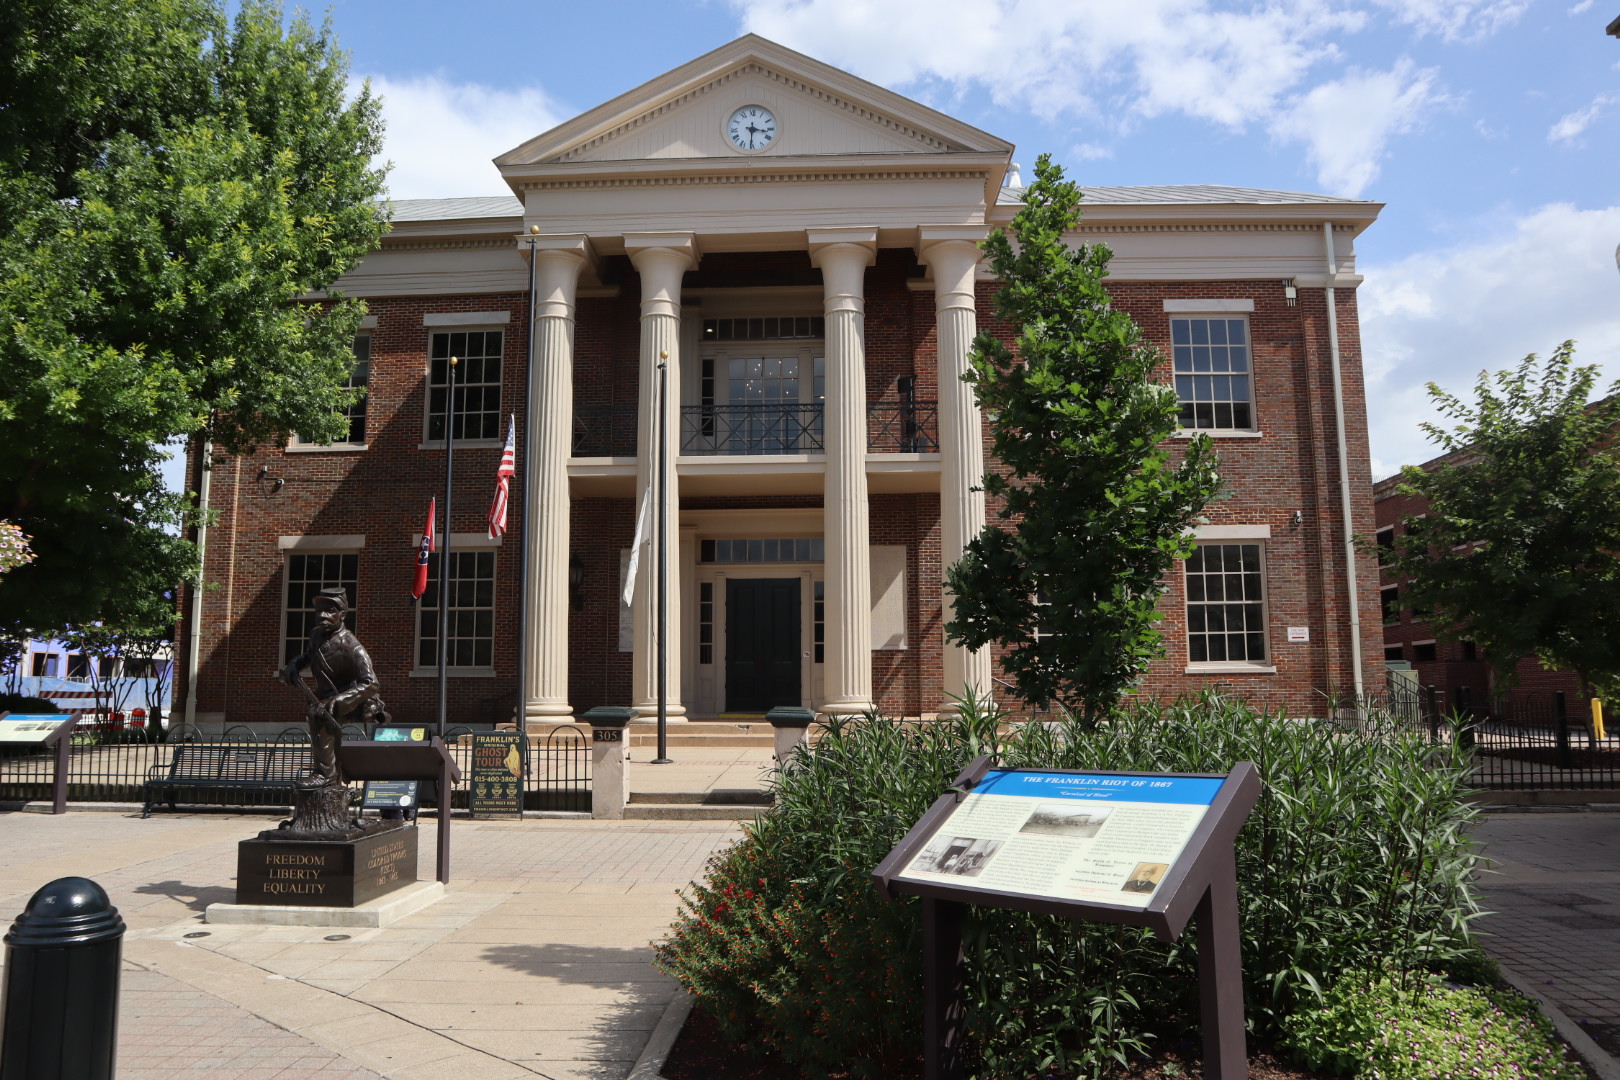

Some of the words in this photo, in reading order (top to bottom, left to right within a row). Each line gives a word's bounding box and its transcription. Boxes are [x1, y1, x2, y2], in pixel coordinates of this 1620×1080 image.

[598, 731, 617, 741] 305
[475, 748, 507, 756] GHOST
[475, 757, 502, 766] TOUR
[266, 855, 325, 865] FREEDOM
[270, 869, 320, 879] LIBERTY
[264, 883, 326, 894] EQUALITY
